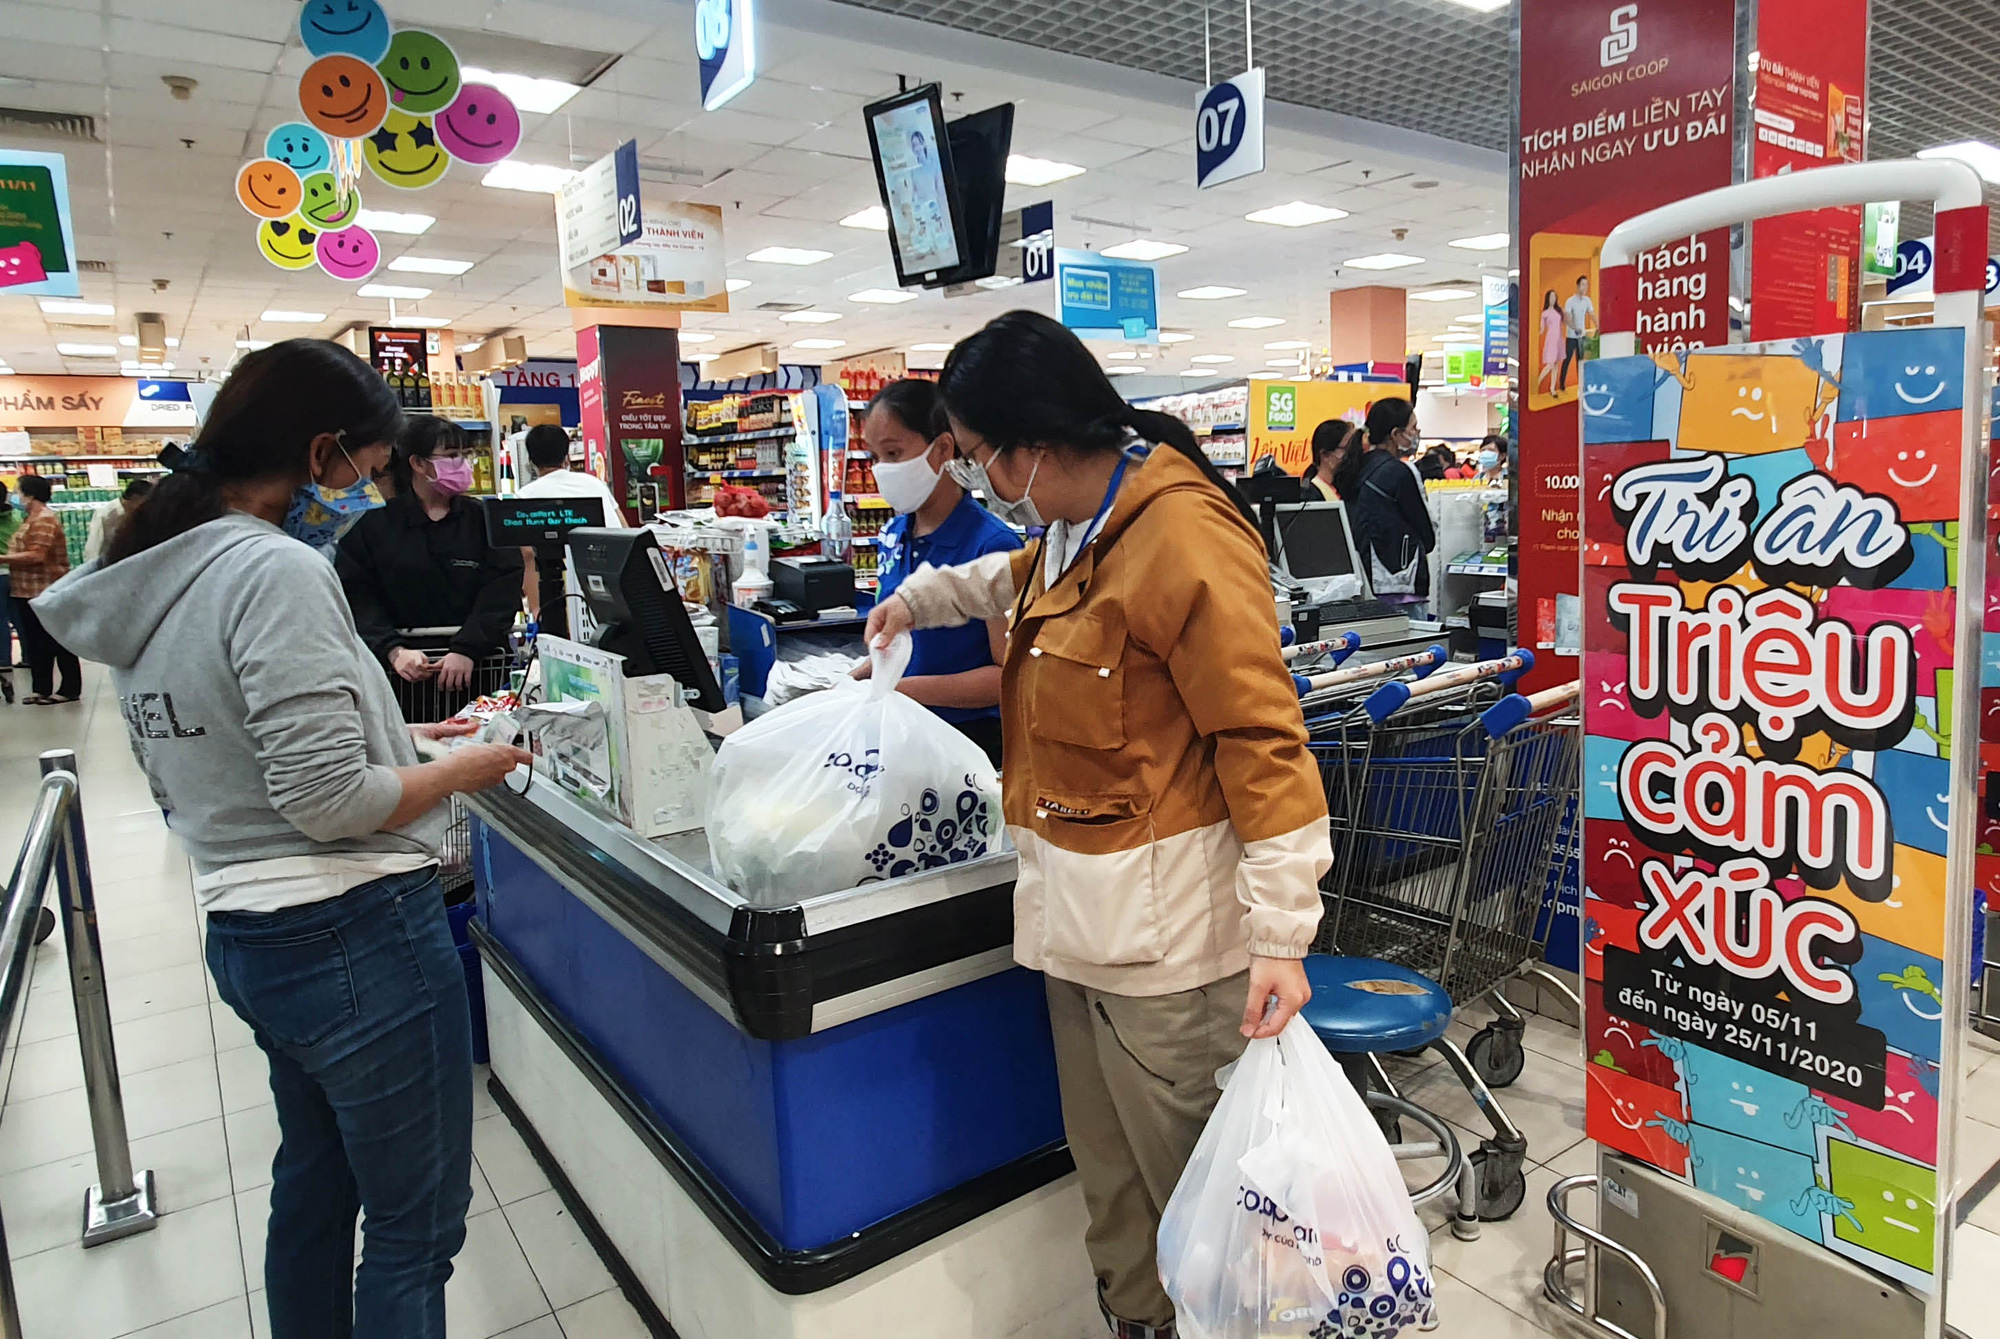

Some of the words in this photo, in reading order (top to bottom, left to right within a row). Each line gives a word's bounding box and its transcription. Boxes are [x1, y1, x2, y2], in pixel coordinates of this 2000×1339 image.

[1571, 70, 1623, 97] SAIGON
[1198, 97, 1240, 152] 07
[1521, 126, 1567, 154] TÍCH
[1573, 106, 1625, 142] ĐIỂM
[1632, 96, 1680, 127] LIỀN
[1687, 85, 1728, 114] TAY
[1521, 152, 1575, 179] NHẬN
[1581, 136, 1637, 166] NGAY
[1643, 126, 1679, 151] ƯU
[1686, 112, 1726, 142] ĐÃI
[619, 194, 638, 237] 02
[646, 226, 679, 237] THÀNH
[681, 229, 704, 239] VIÊN
[1026, 244, 1048, 277] 01
[1638, 273, 1706, 302] hàng
[568, 373, 575, 388] 1
[0, 390, 55, 411] HẨM
[62, 391, 103, 411] SẤY
[1268, 411, 1293, 423] FOOD
[1270, 393, 1293, 412] SG
[1541, 509, 1574, 523] Nhận
[1616, 458, 1744, 562] Tri
[1757, 478, 1902, 564] ân
[1556, 529, 1579, 540] cho
[1611, 590, 1904, 736] Triệu
[1624, 715, 1881, 876] cảm
[1643, 862, 1850, 1000] xúc
[1650, 968, 1682, 996] Từ
[1688, 985, 1745, 1015] ngày
[1751, 1003, 1818, 1041] 05/11
[1618, 986, 1658, 1016] đến
[1663, 1004, 1719, 1040] ngày
[1724, 1023, 1863, 1089] 25/11/2020
